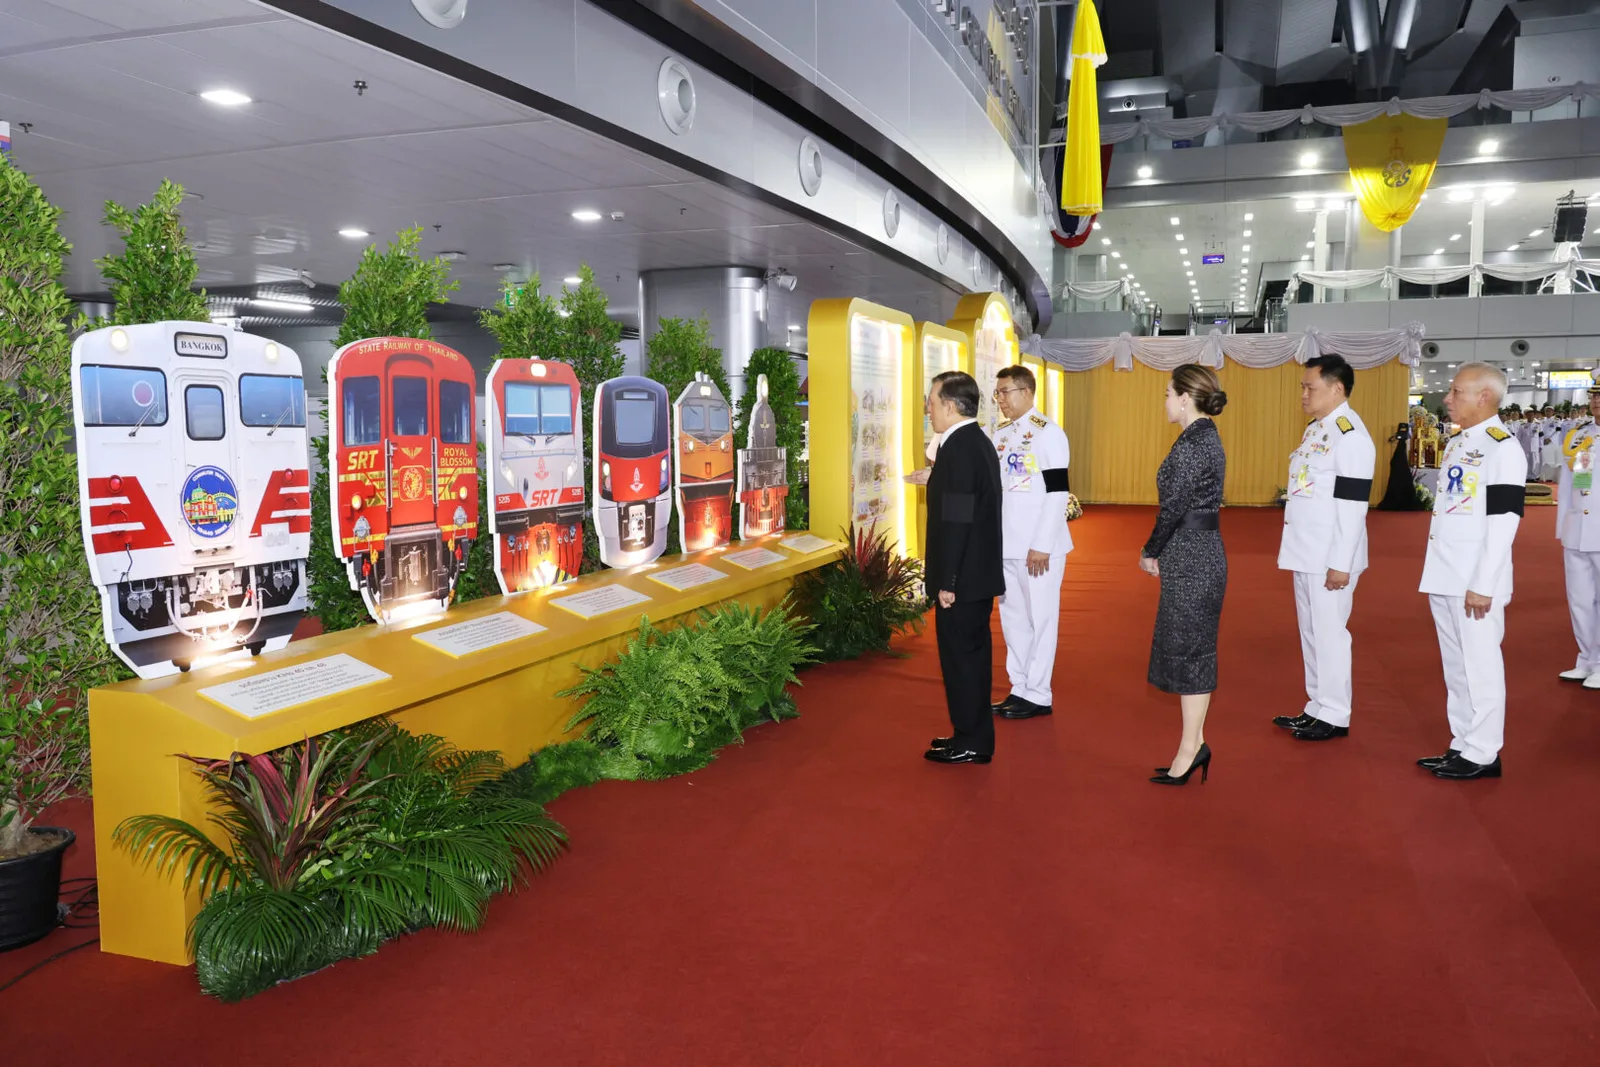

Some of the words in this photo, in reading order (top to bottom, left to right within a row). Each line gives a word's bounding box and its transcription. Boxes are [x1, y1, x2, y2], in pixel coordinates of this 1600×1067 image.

[181, 340, 223, 352] BANGKOK
[359, 342, 381, 355] STATE
[383, 341, 412, 351] RAILWAY
[414, 342, 424, 351] OF
[428, 345, 459, 361] THAILAND
[443, 447, 469, 457] ROYAL
[347, 449, 379, 471] SRT
[440, 457, 473, 467] BLOSSOM
[530, 488, 559, 507] SRT
